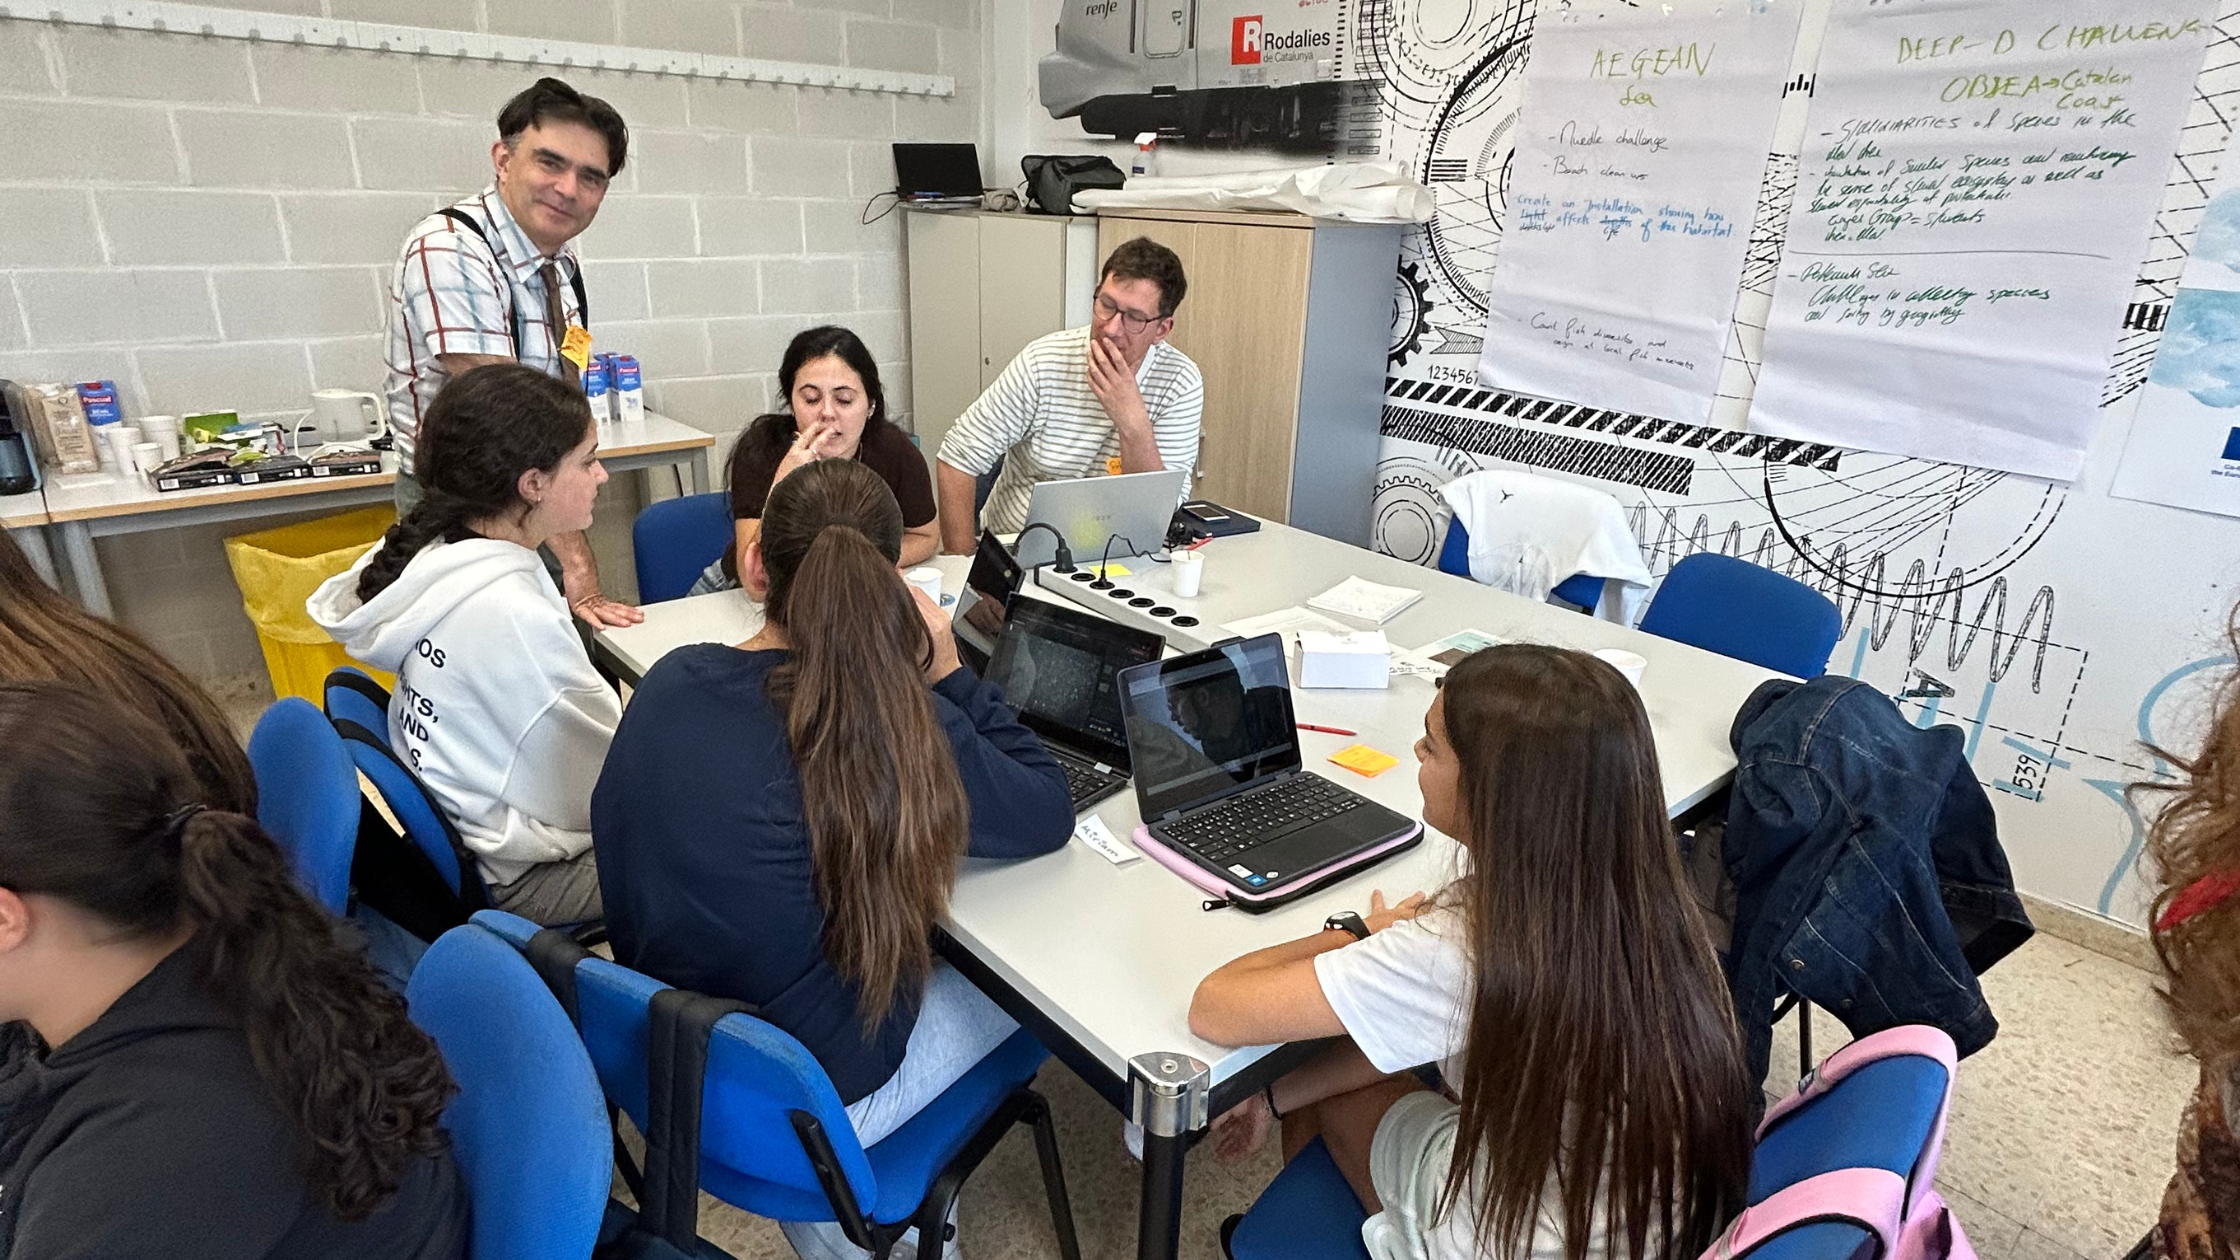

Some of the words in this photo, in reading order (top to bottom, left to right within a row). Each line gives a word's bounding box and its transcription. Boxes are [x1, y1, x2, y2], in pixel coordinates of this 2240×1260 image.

[1264, 29, 1331, 51] Rodalies
[1263, 53, 1274, 63] de
[1274, 51, 1314, 63] Catalunya
[1589, 42, 1717, 80] AEGEAN
[1615, 128, 1669, 154] challenge
[1552, 154, 1588, 176] Beach
[1517, 193, 1551, 207] Create
[1659, 204, 1695, 225] showing
[1703, 206, 1725, 221] how
[1556, 211, 1590, 227] affects
[1986, 288, 2051, 305] species
[1565, 318, 1586, 340] fish
[1629, 348, 1648, 362] fish
[2012, 753, 2041, 790] 539
